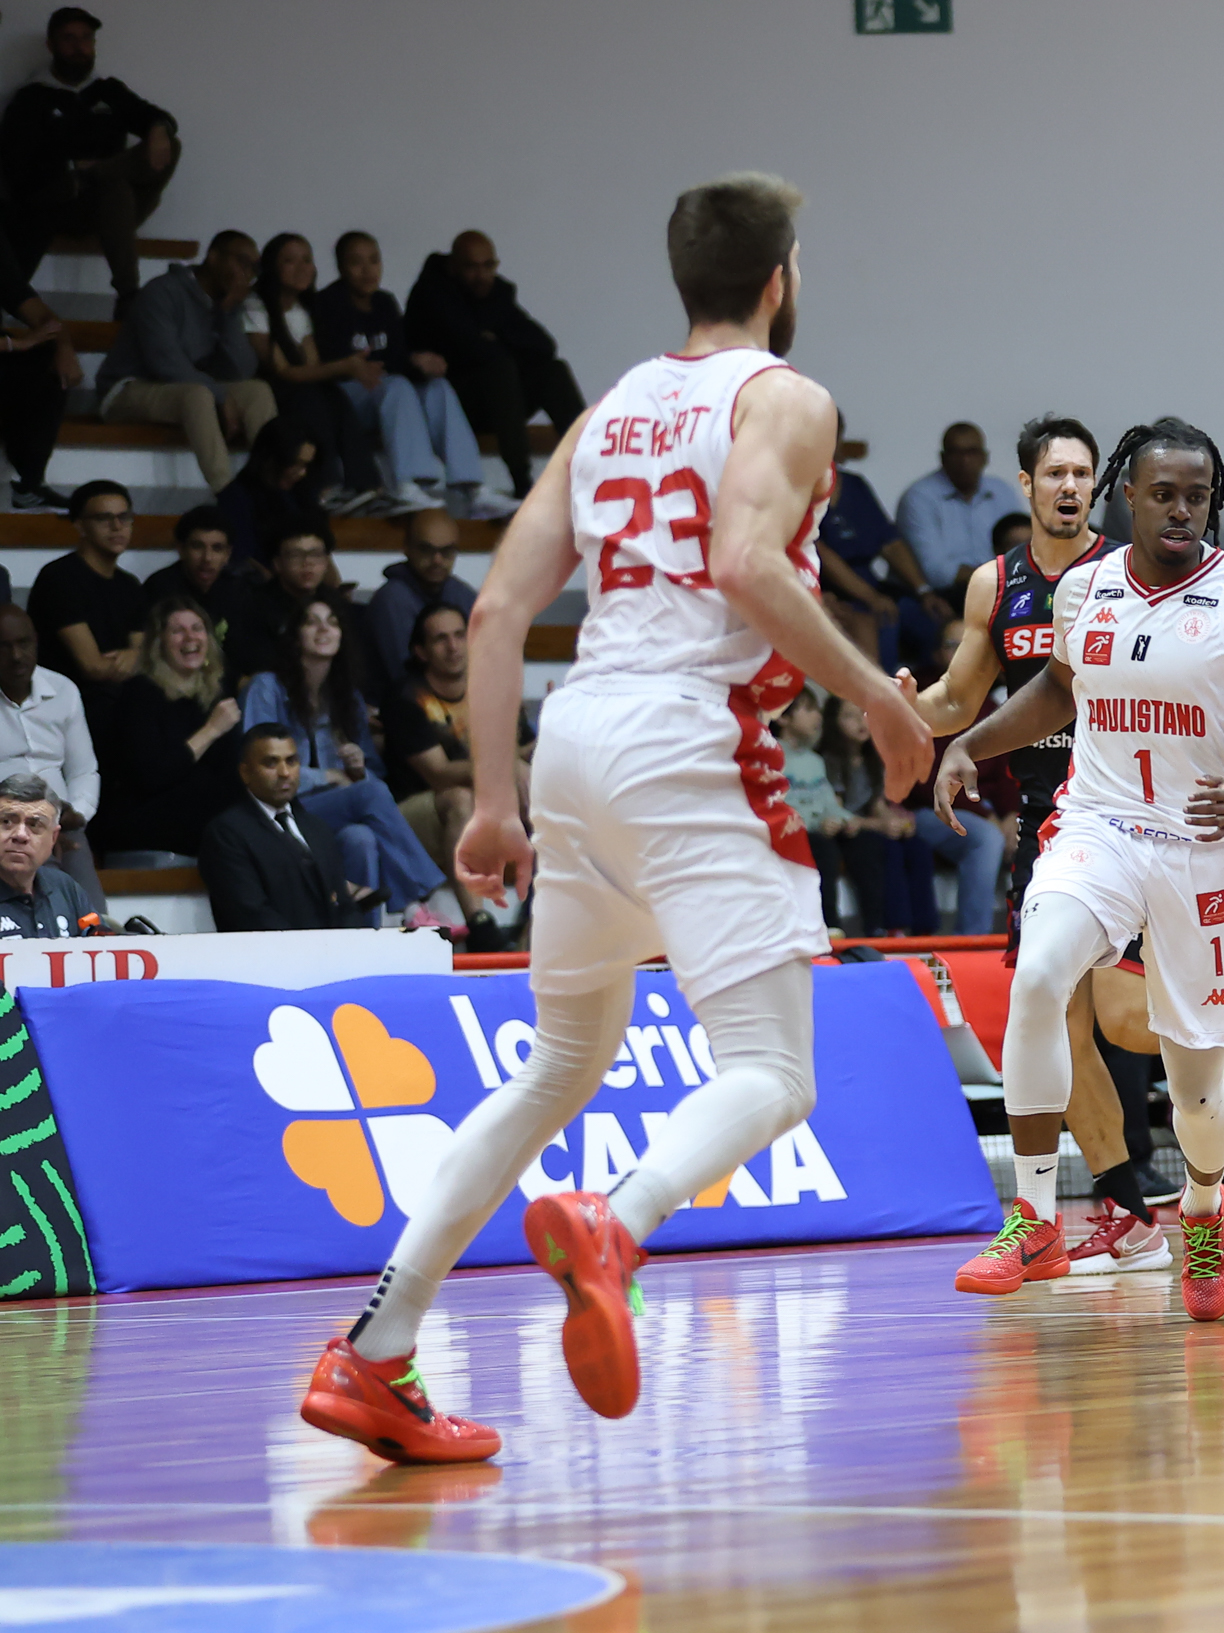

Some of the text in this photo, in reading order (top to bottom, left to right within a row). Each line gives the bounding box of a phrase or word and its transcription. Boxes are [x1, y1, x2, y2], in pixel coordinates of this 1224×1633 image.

[594, 467, 717, 595] 23
[1011, 628, 1054, 657] SE
[1087, 698, 1207, 738] PAULISTANO
[1134, 749, 1155, 804] 1
[1210, 936, 1224, 976] 1
